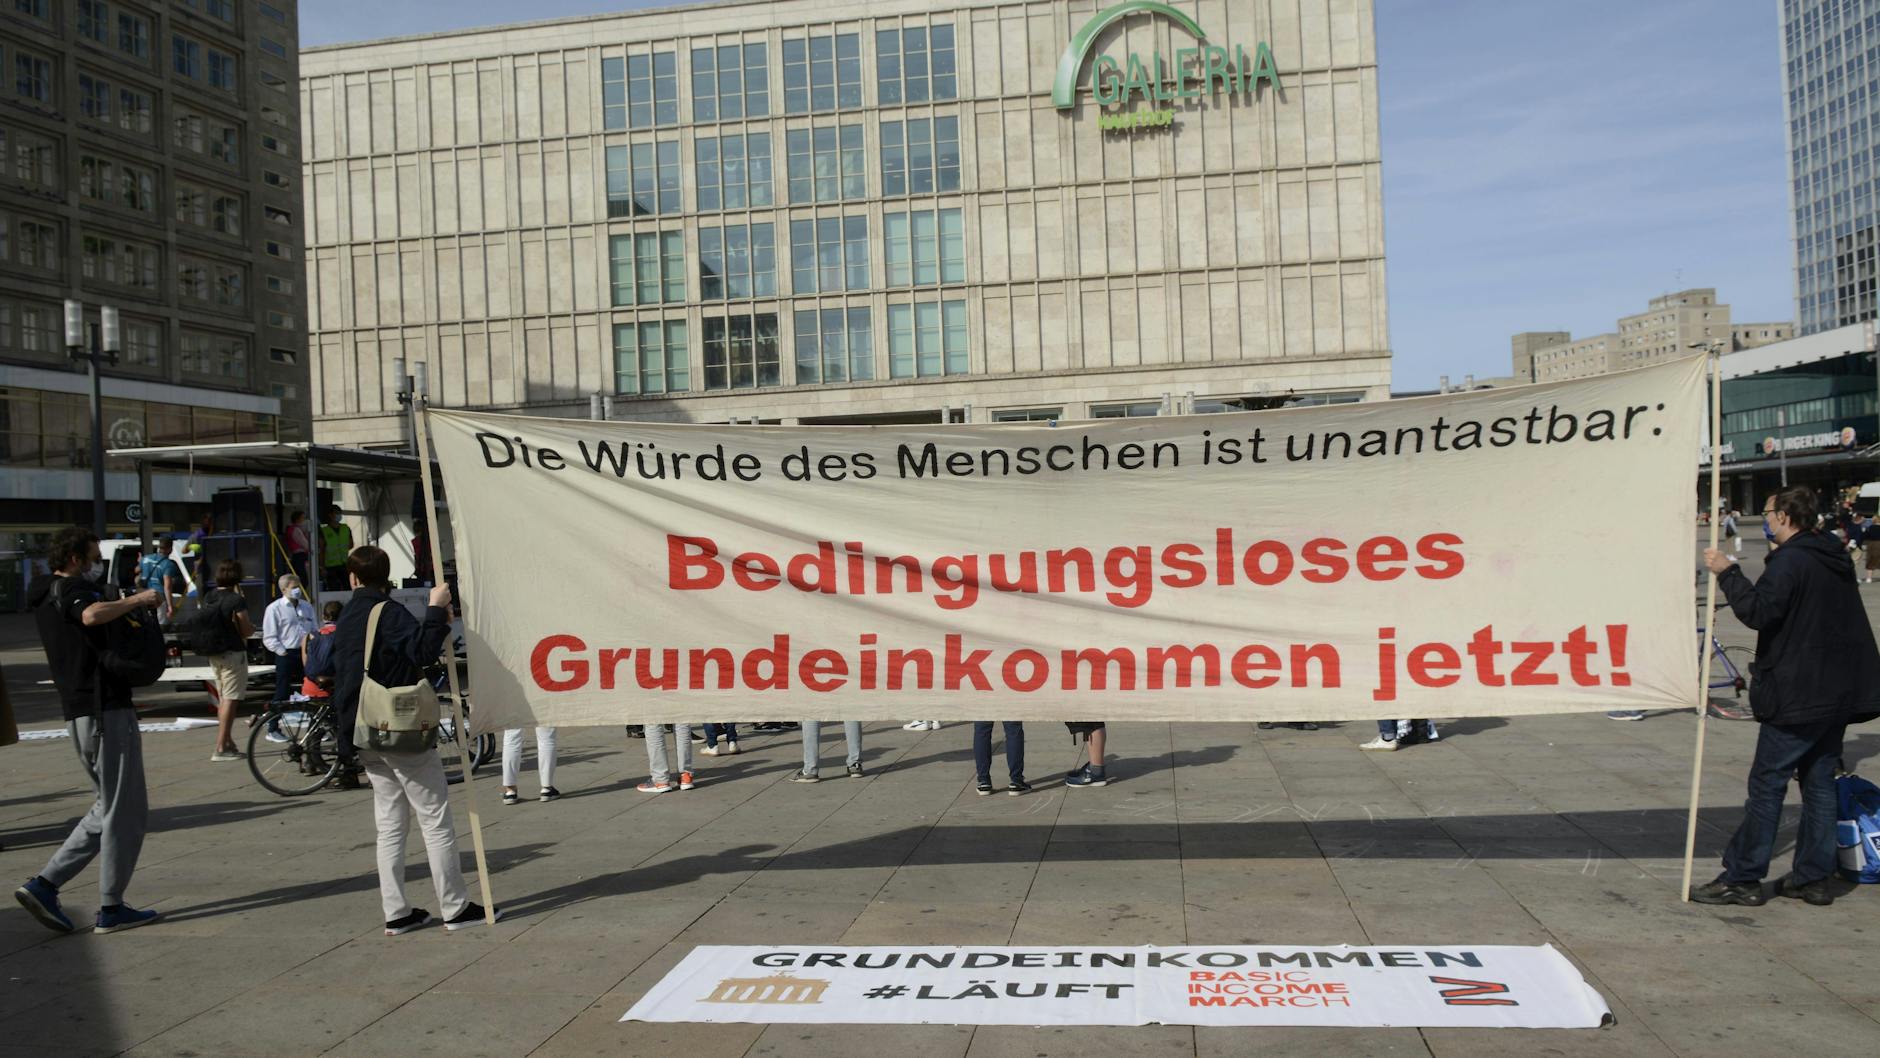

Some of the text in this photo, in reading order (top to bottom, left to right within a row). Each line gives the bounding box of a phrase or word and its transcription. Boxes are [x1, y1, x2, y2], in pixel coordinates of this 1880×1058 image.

[1093, 41, 1281, 106] GALERIA
[476, 403, 1665, 482] Die Würde des Menschen ist unantastbar:
[1814, 431, 1841, 447] KING
[667, 528, 1465, 611] Bedingungsloses
[531, 623, 1633, 702] Grundeinkommen jetzt!
[752, 951, 1483, 969] GRUNDEINKOMMEN
[1189, 970, 1311, 982] BASIC
[863, 980, 1134, 1001] #LÄUFT
[1187, 983, 1350, 995] INCOME
[1188, 996, 1350, 1007] MARCH
